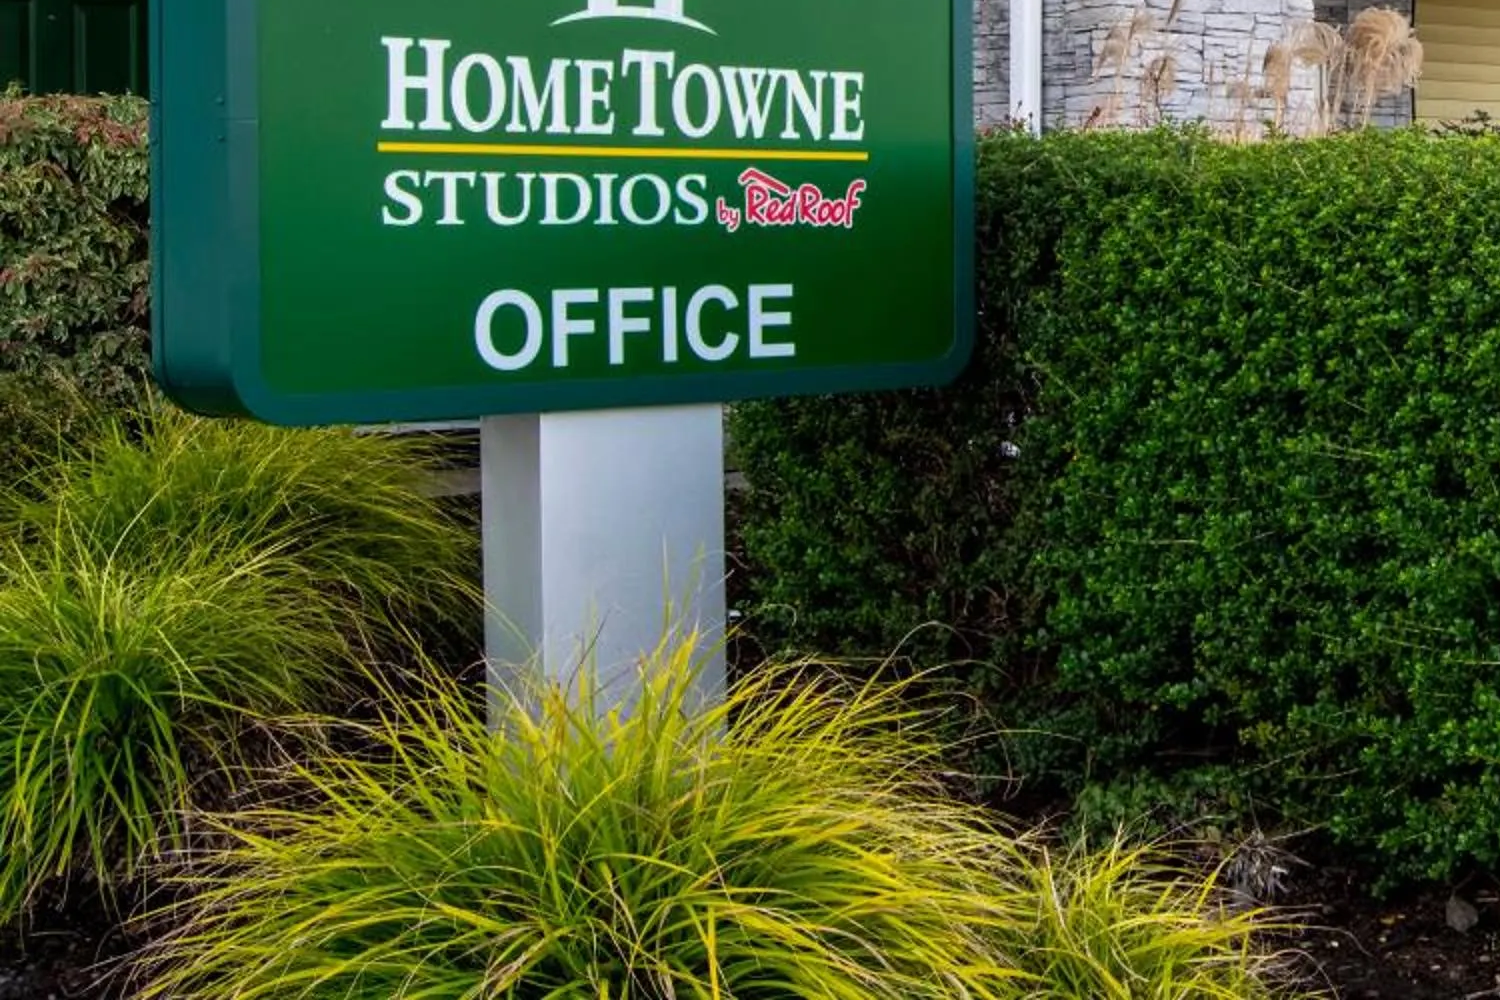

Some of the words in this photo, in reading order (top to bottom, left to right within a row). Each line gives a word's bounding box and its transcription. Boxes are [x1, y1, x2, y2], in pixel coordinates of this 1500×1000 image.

[381, 169, 709, 226] STUDIOS
[716, 196, 741, 232] by
[474, 283, 796, 371] OFFICE
